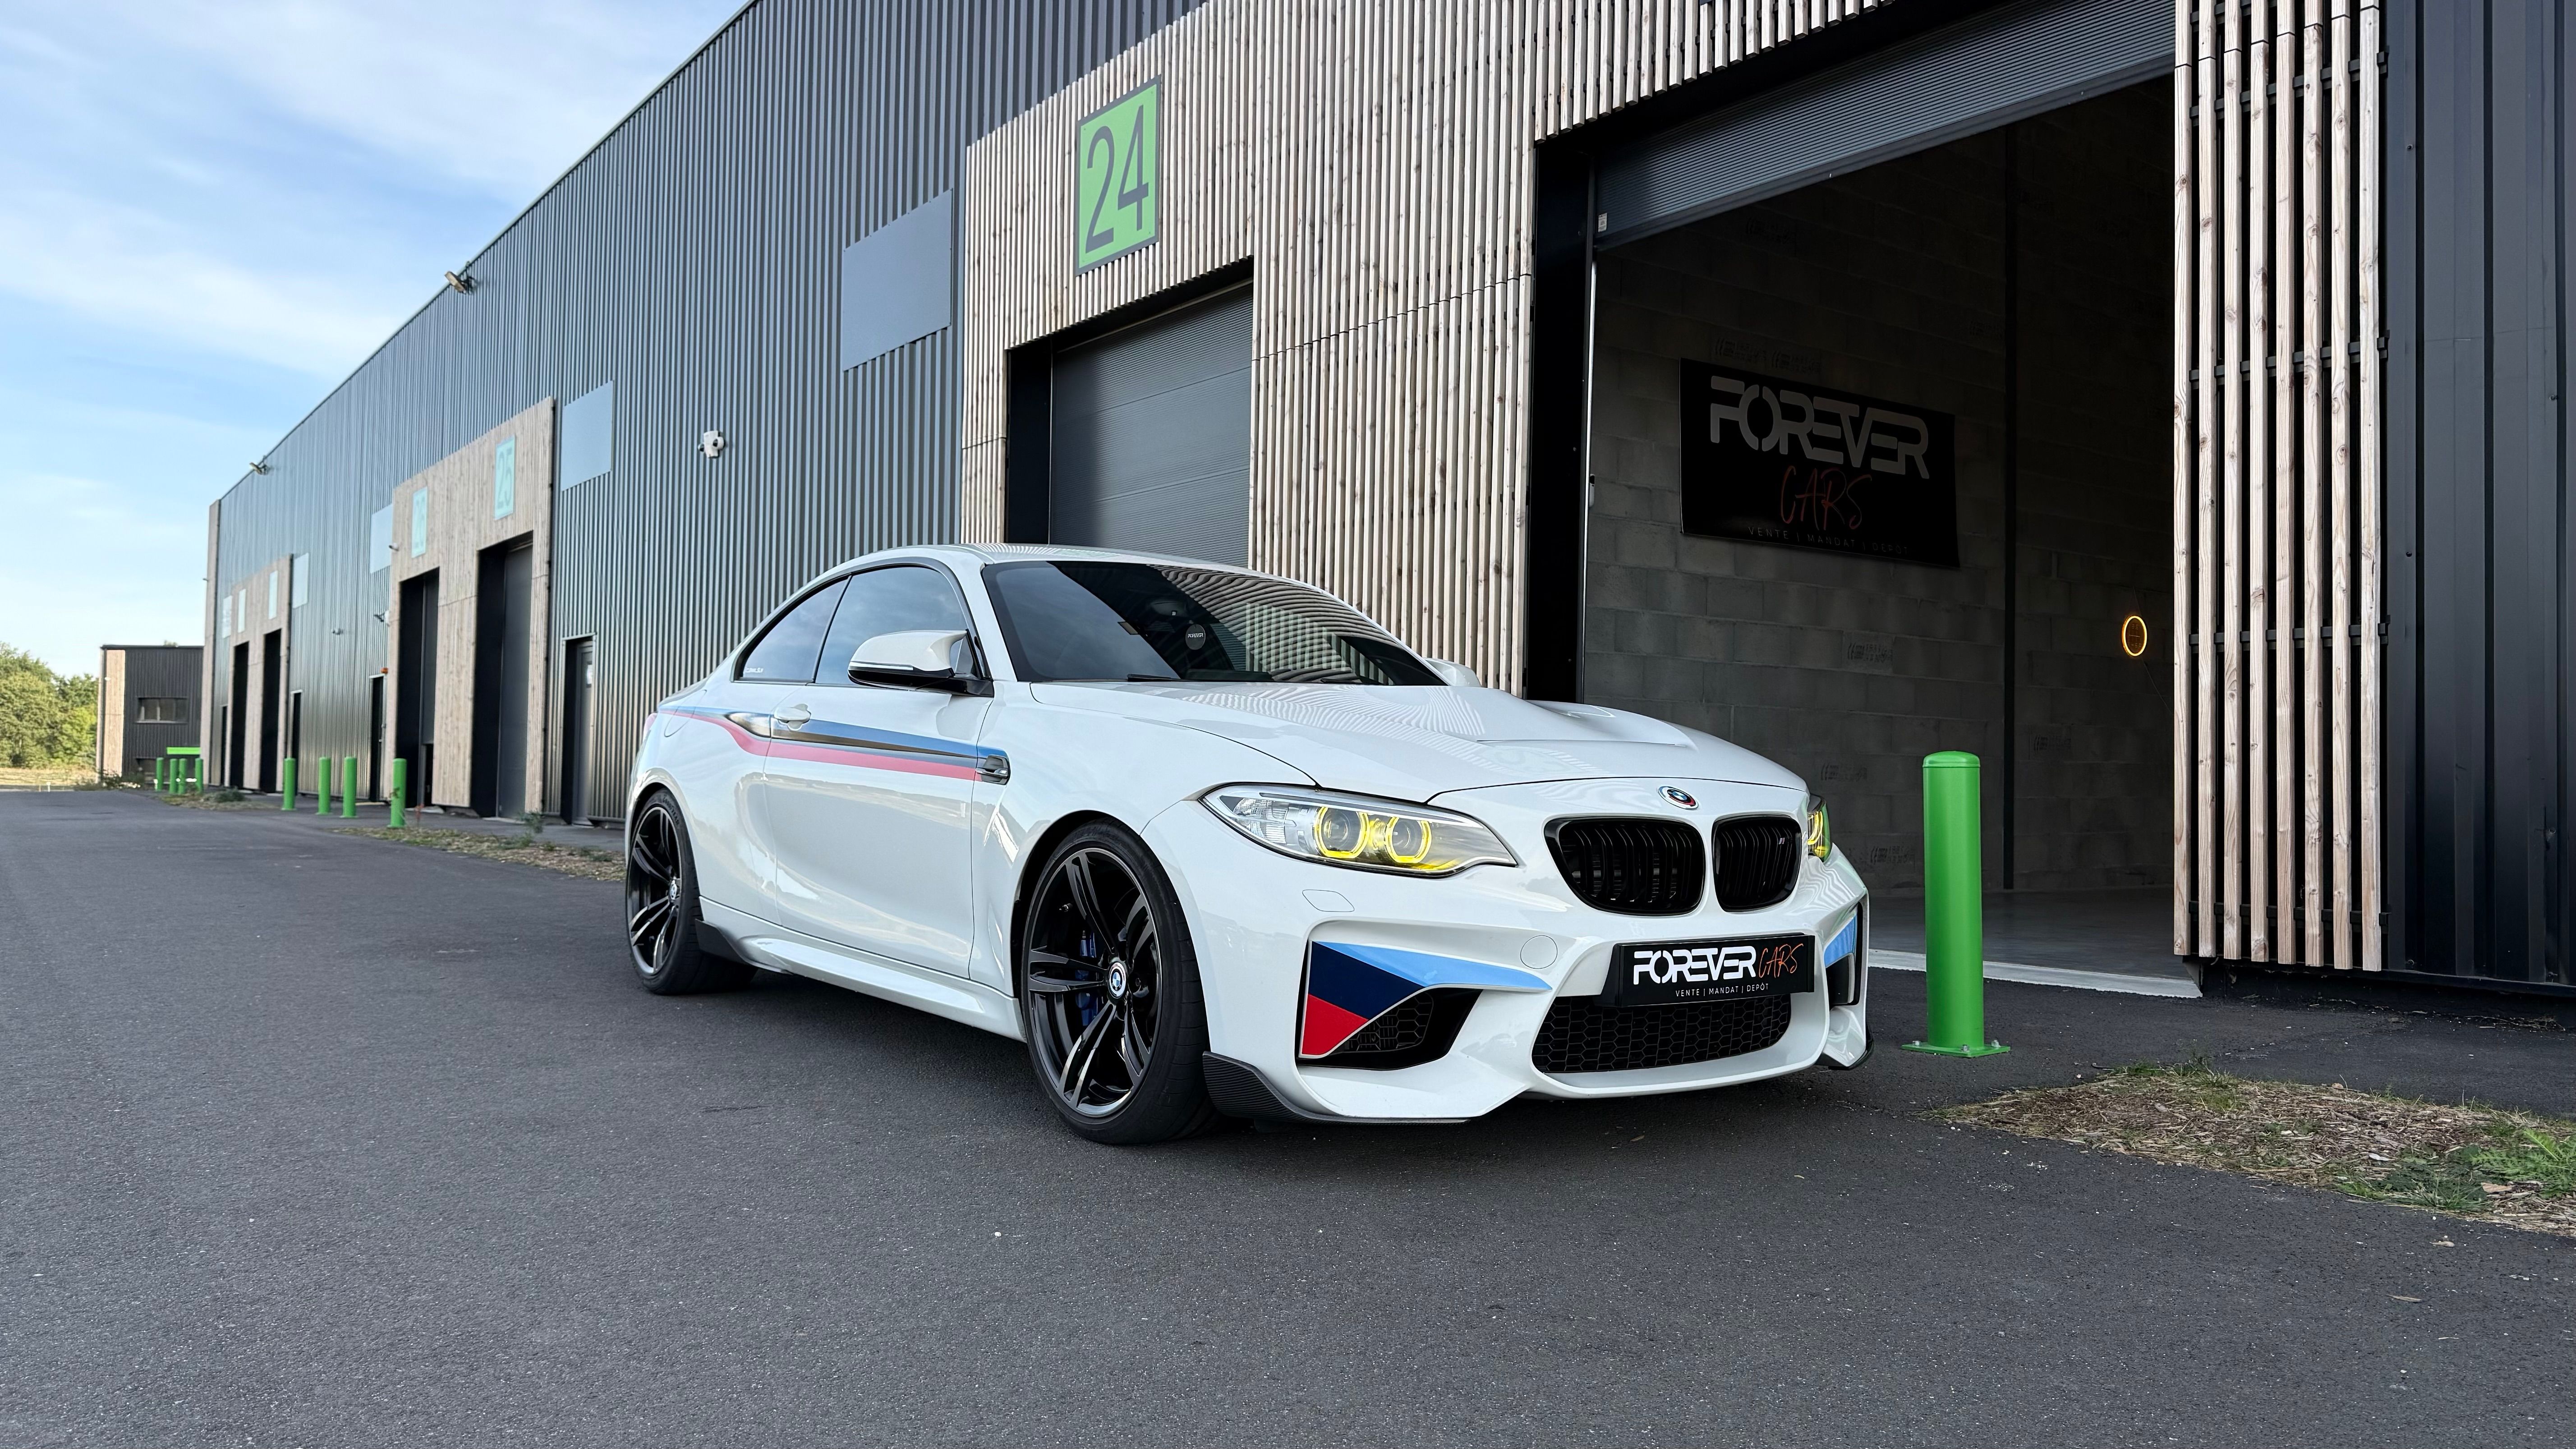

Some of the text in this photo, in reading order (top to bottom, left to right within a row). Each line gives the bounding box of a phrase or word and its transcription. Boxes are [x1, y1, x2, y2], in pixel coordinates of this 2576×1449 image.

[1086, 105, 1149, 254] 24
[1710, 375, 1929, 479] FOREVER
[497, 447, 512, 509] 25
[1780, 465, 1872, 530] CARS
[1748, 526, 1789, 540] VENTE
[1807, 534, 1855, 548] MANDAT
[1633, 943, 1804, 985] FOREVER CARS
[1675, 989, 1700, 997] VENTE
[1709, 985, 1739, 995] MANDAT
[1747, 982, 1769, 992] DEPÔT
